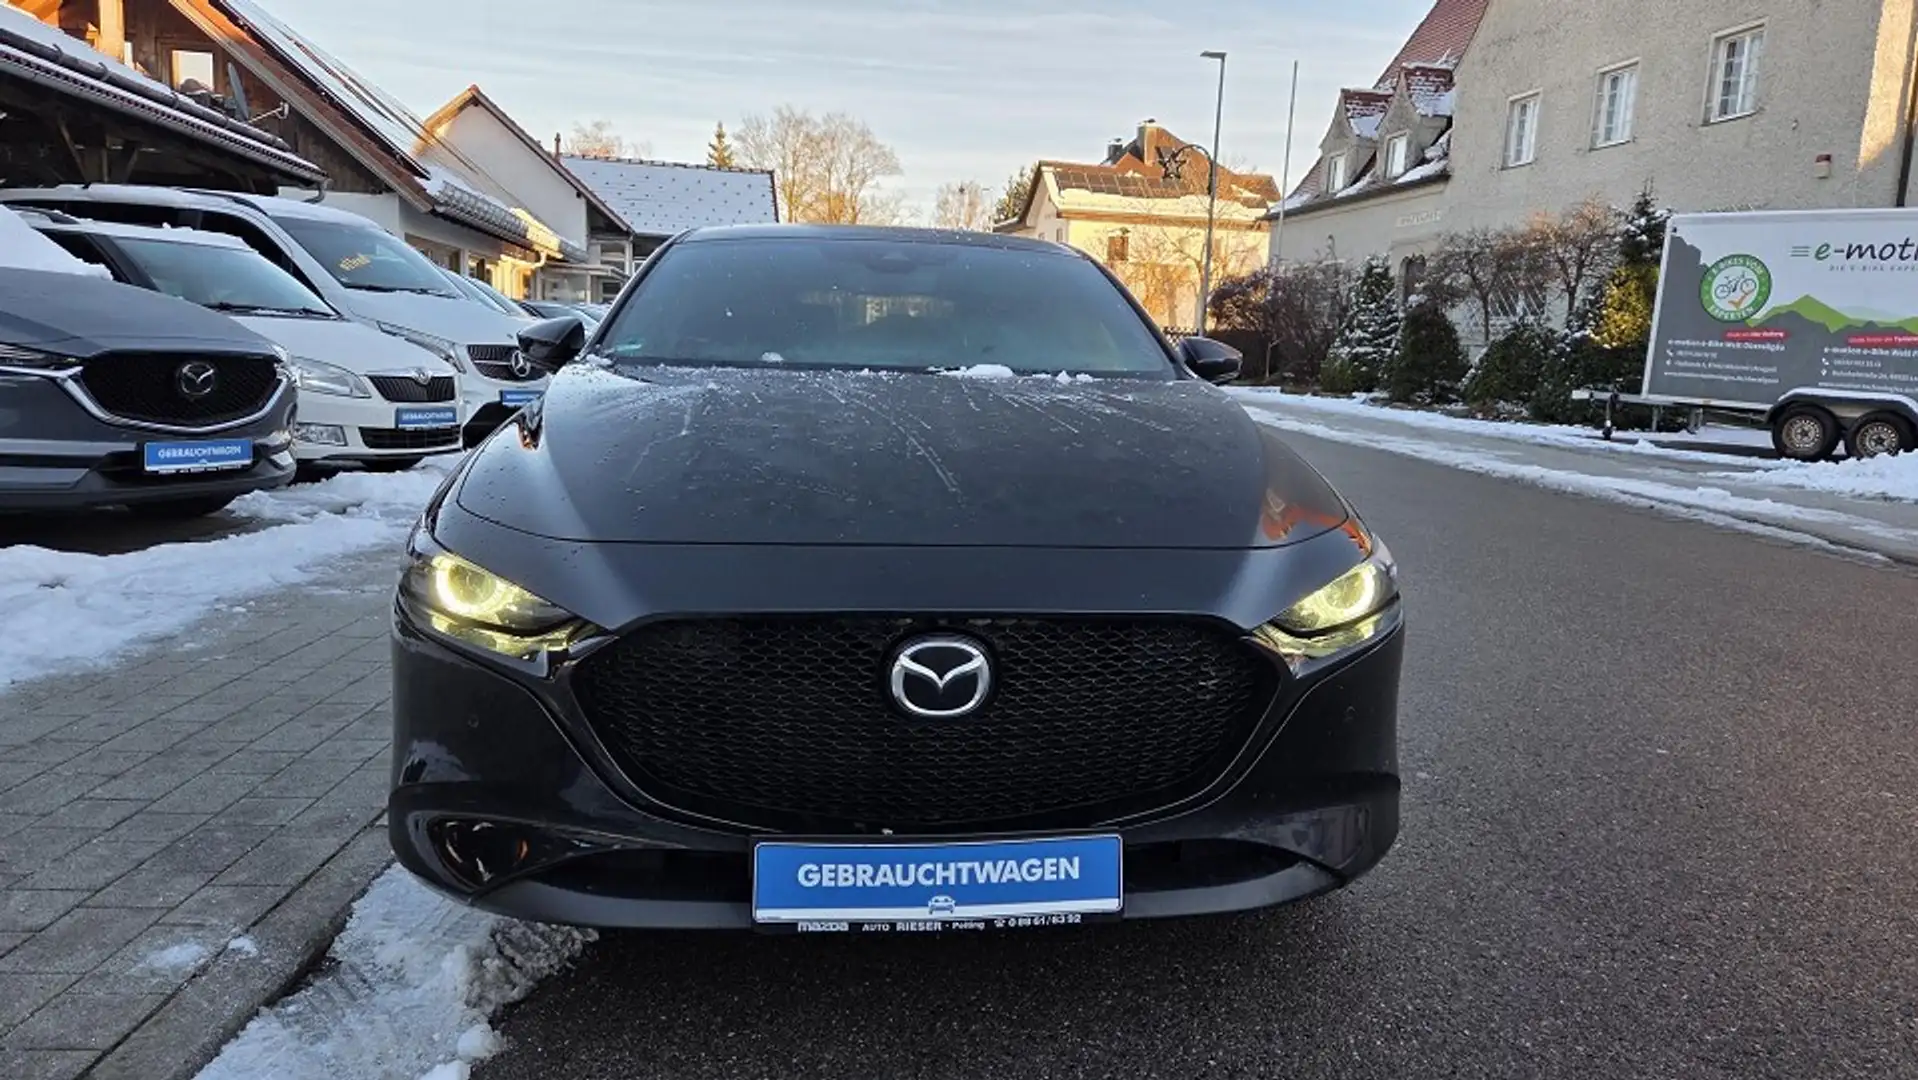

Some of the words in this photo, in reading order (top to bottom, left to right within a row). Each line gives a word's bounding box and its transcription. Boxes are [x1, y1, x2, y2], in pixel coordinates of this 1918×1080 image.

[157, 445, 242, 459] GEBRAUCHTWAGEN
[797, 856, 1080, 888] GEBRAUCHTWAGEN
[862, 923, 890, 932] AUTO
[896, 922, 942, 931] RIESER
